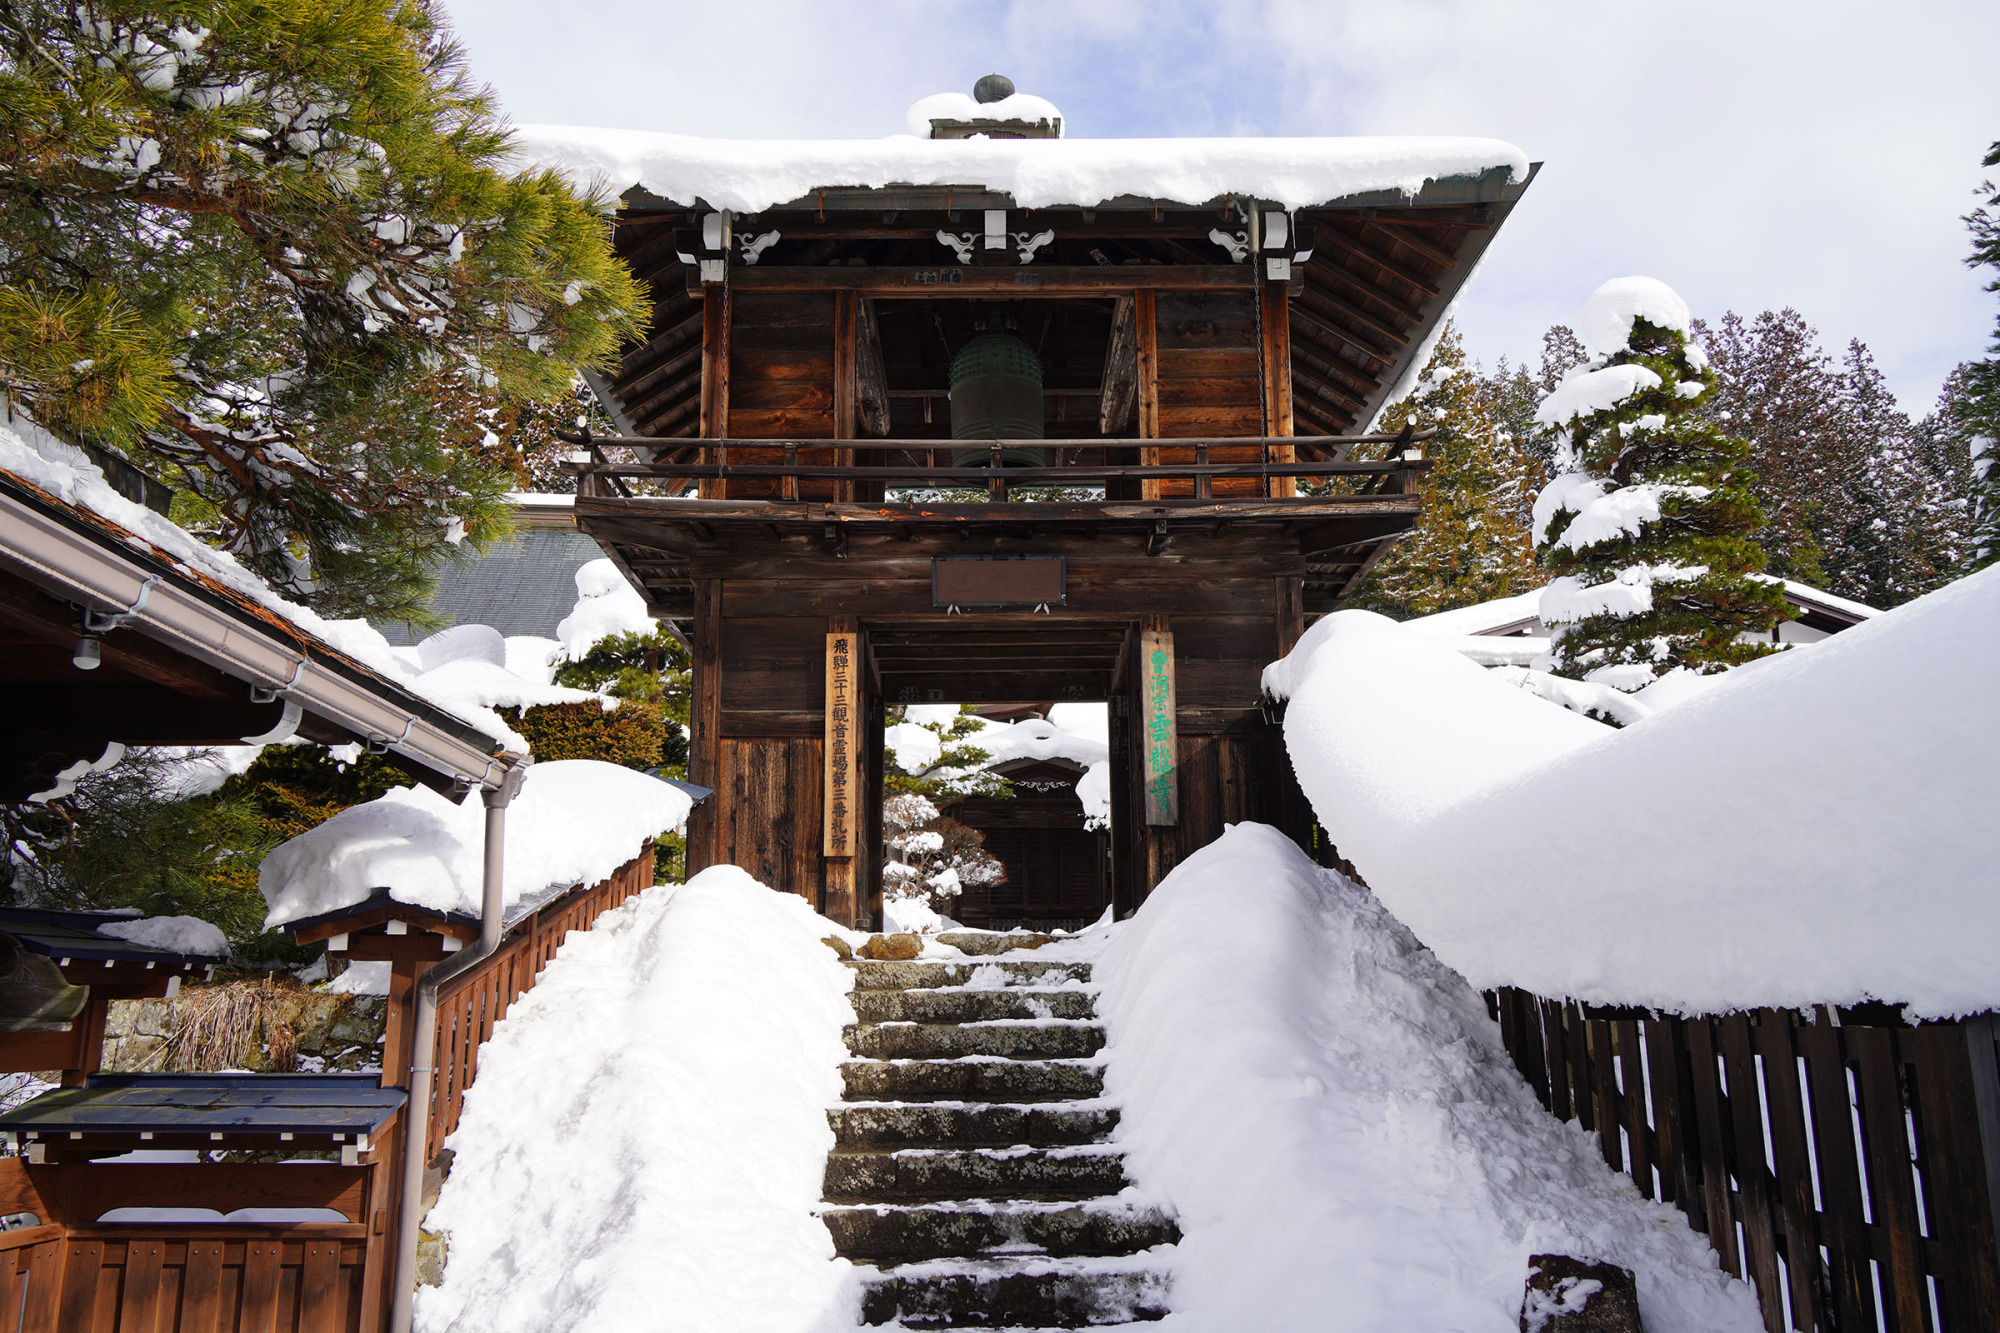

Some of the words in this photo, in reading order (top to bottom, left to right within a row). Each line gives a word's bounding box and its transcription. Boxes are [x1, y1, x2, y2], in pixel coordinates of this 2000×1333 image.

[831, 638, 849, 851] 飛騨三十三観音霊場第三番札所
[1147, 650, 1175, 812] 曹洞宗雲龍寺
